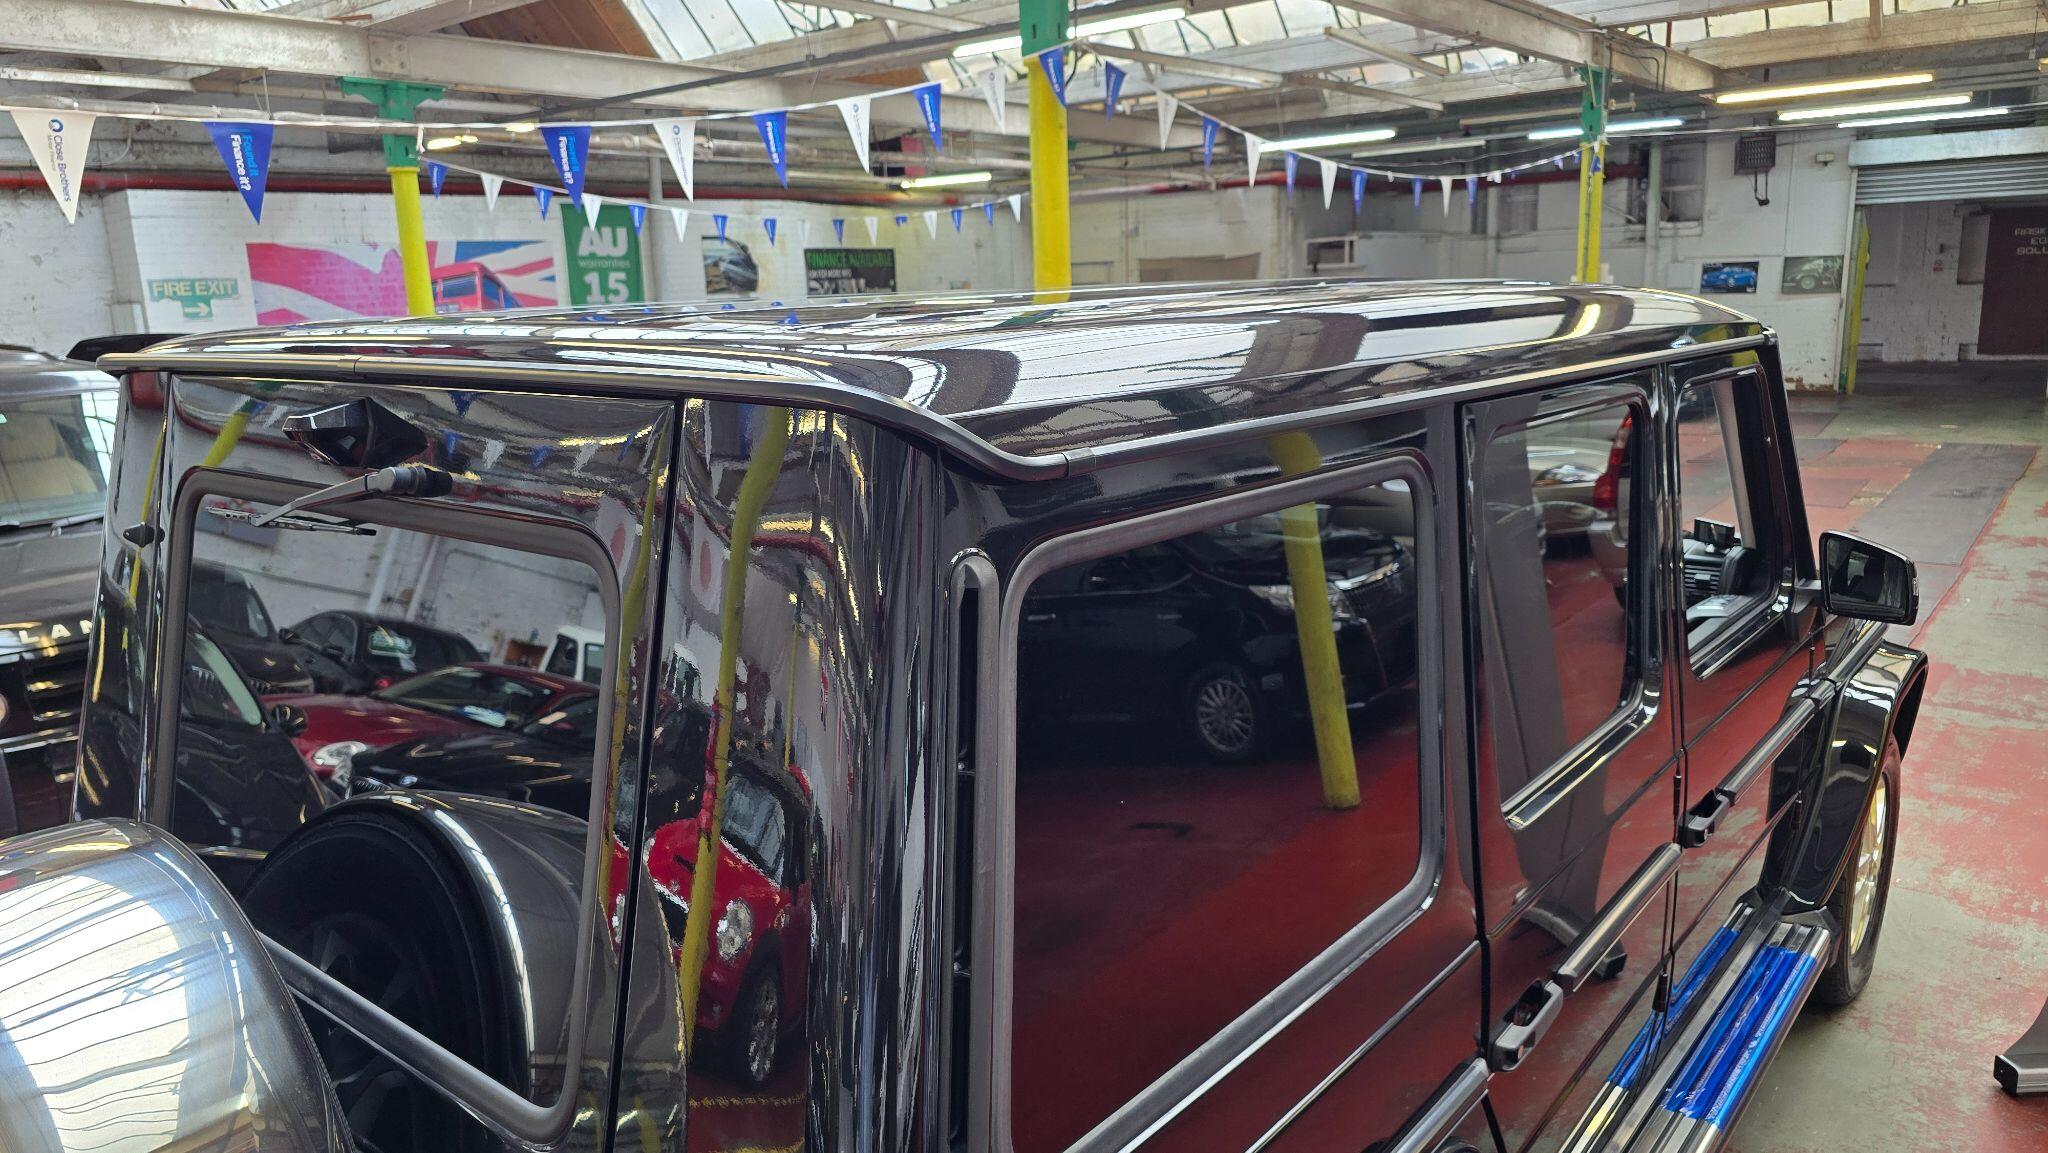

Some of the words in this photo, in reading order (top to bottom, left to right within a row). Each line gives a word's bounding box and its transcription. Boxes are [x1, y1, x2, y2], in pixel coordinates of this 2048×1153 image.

[54, 135, 64, 161] Close
[231, 134, 246, 176] Finance
[239, 176, 252, 191] it?
[58, 163, 71, 202] Brothers
[577, 226, 629, 257] AU
[152, 281, 192, 297] FIRE
[195, 280, 237, 296] EXIT
[584, 271, 629, 304] 15
